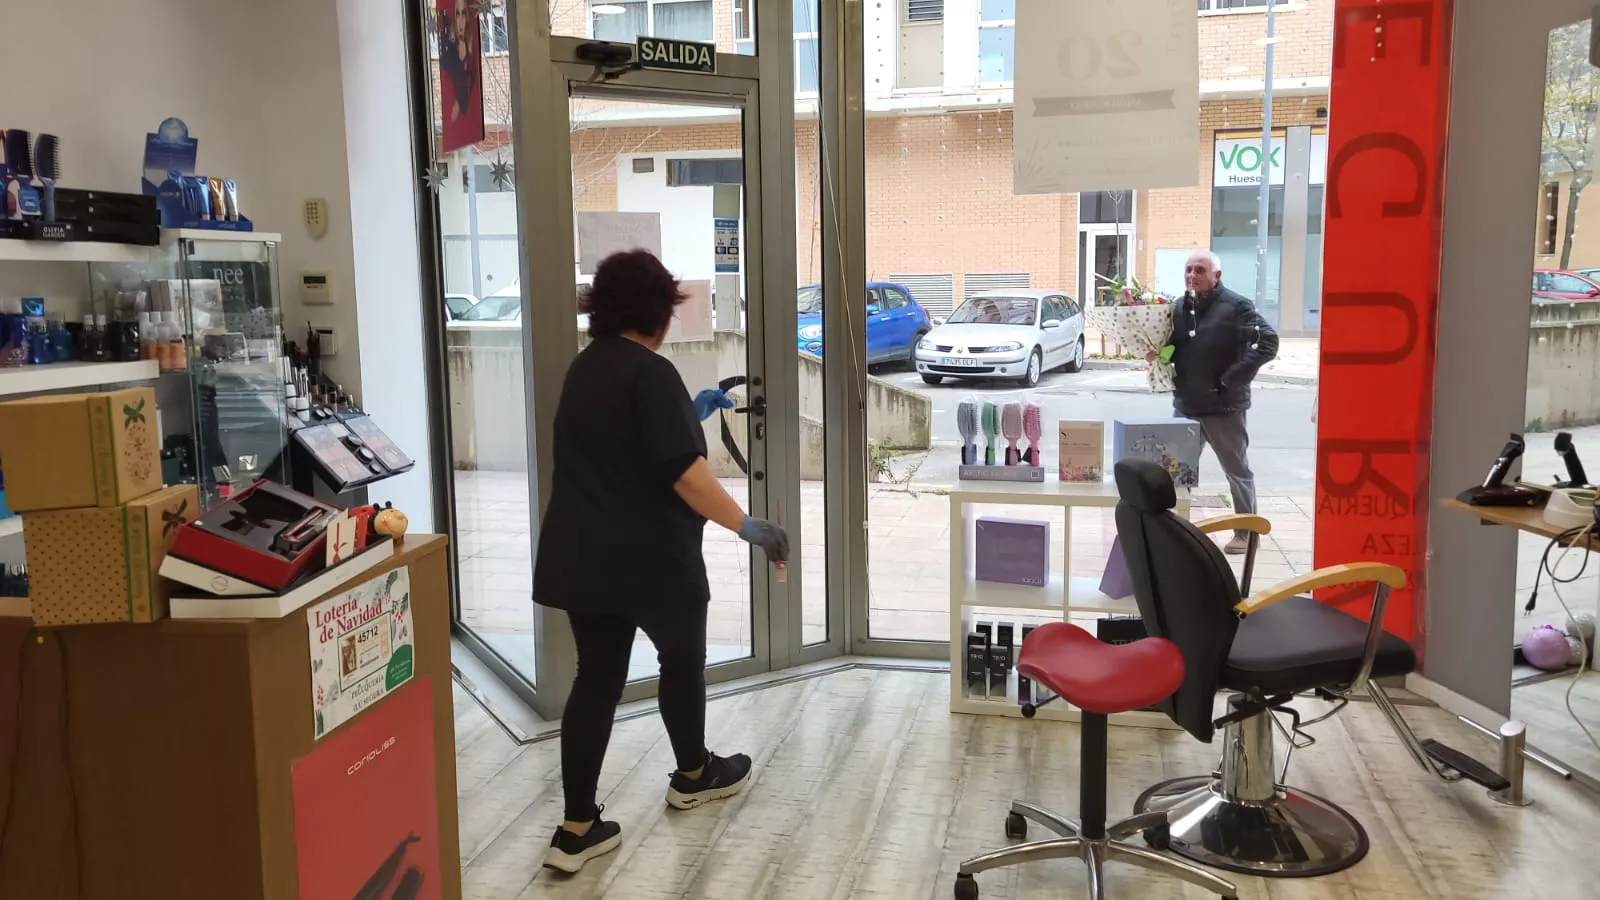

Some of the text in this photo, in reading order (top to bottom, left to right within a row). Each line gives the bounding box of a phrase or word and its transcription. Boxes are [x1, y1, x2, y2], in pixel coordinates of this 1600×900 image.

[641, 41, 711, 66] SALIDA
[1219, 144, 1281, 172] VOX
[1229, 175, 1263, 183] Huesc
[212, 267, 244, 285] nee
[319, 598, 383, 644] de Navidad
[358, 625, 378, 643] 45712
